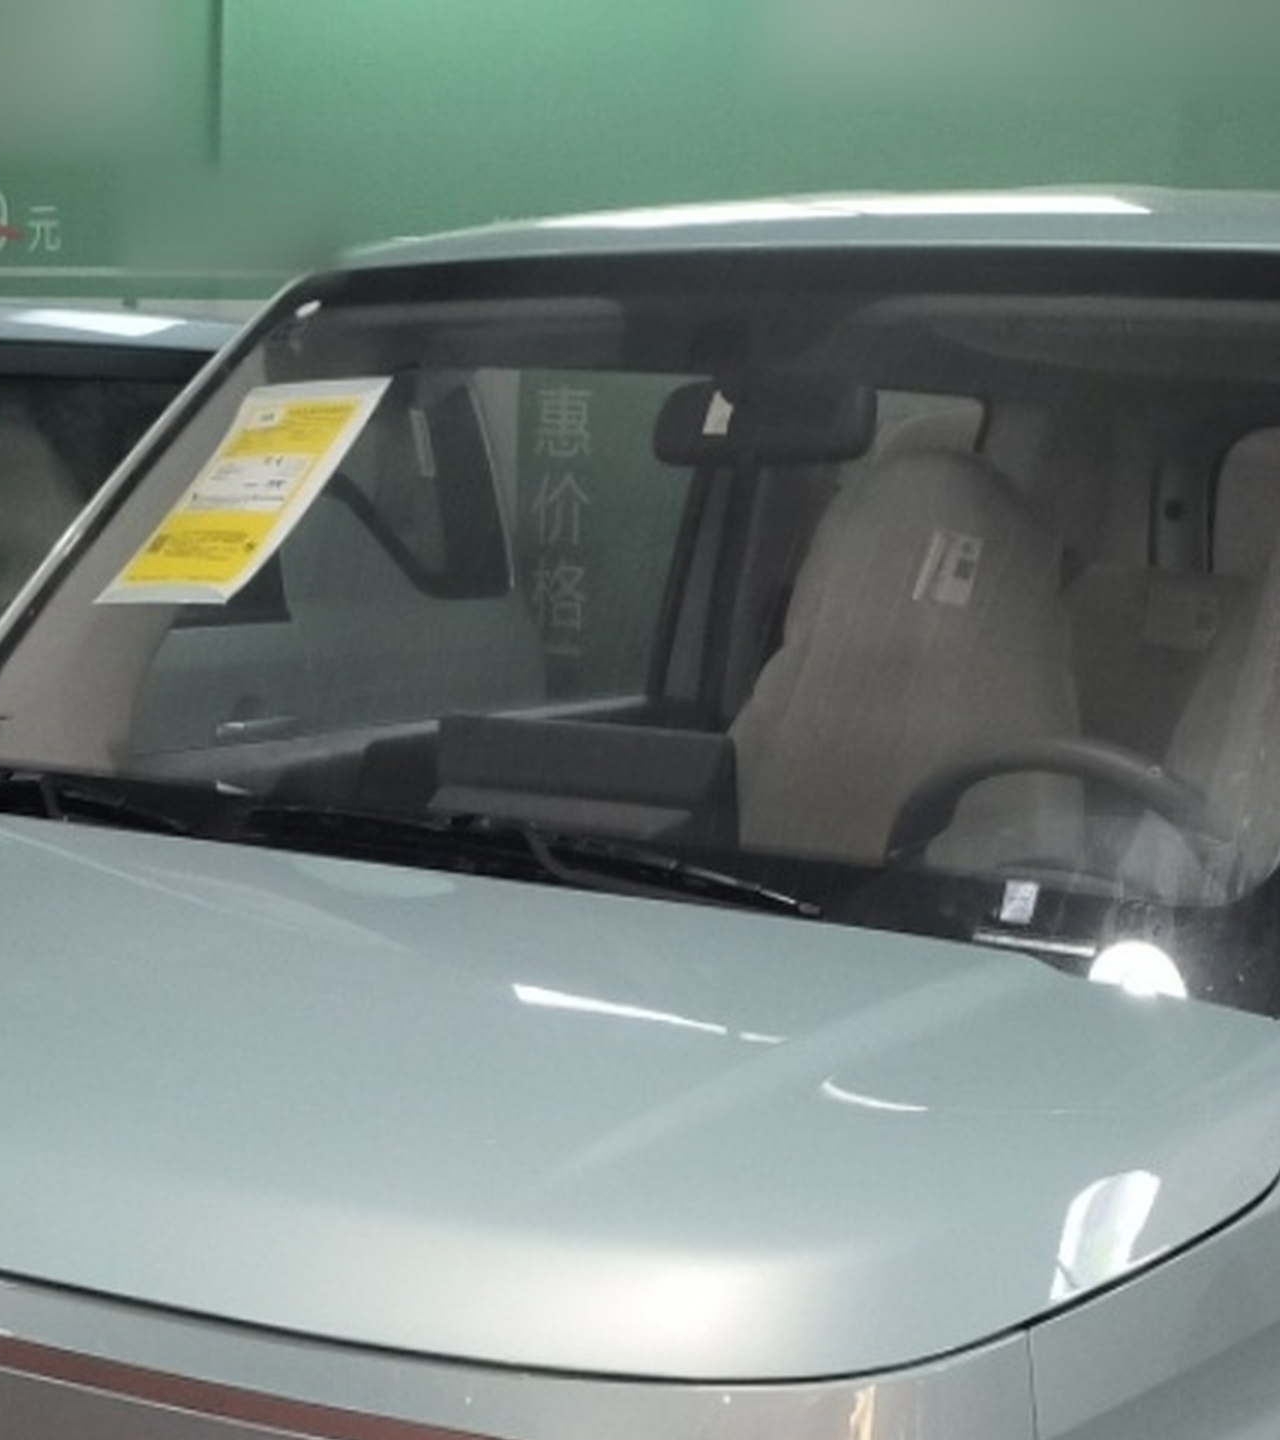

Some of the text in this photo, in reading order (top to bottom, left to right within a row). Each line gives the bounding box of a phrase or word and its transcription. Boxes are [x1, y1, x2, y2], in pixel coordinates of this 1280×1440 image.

[27, 205, 62, 253] 元
[531, 384, 591, 656] 惠价格
